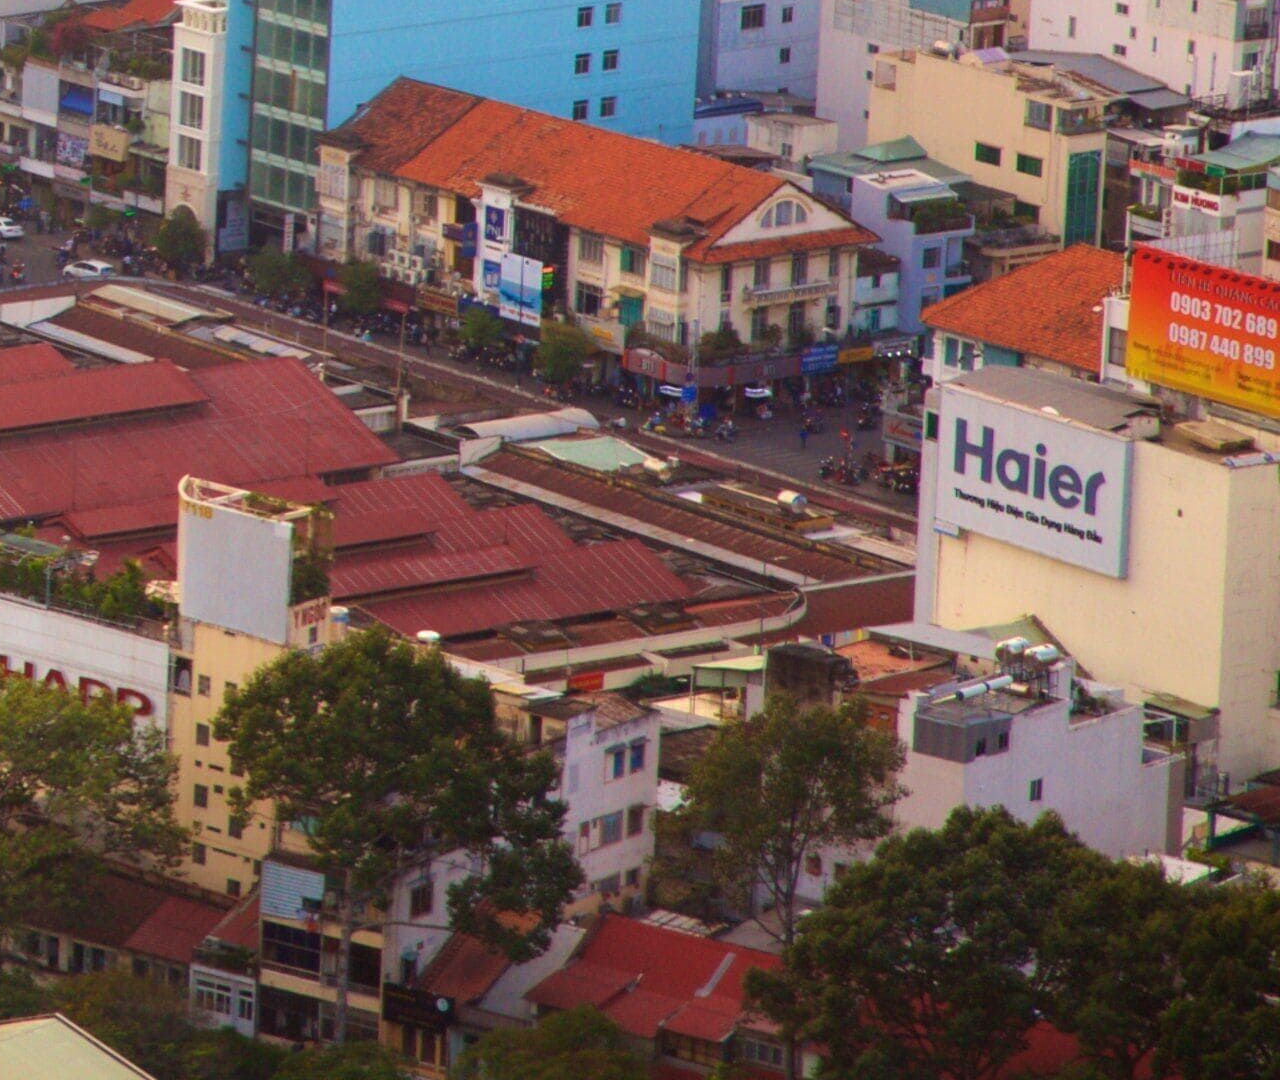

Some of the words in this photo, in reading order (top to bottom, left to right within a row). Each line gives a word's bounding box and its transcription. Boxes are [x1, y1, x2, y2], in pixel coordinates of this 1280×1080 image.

[1170, 291, 1211, 322] 0903
[1214, 303, 1243, 330] 702
[1245, 312, 1278, 340] 689
[1168, 322, 1208, 351] 0987
[1210, 334, 1240, 361] 440
[1243, 343, 1276, 370] 899
[954, 417, 1106, 516] Haier
[1025, 511, 1040, 524] Gia
